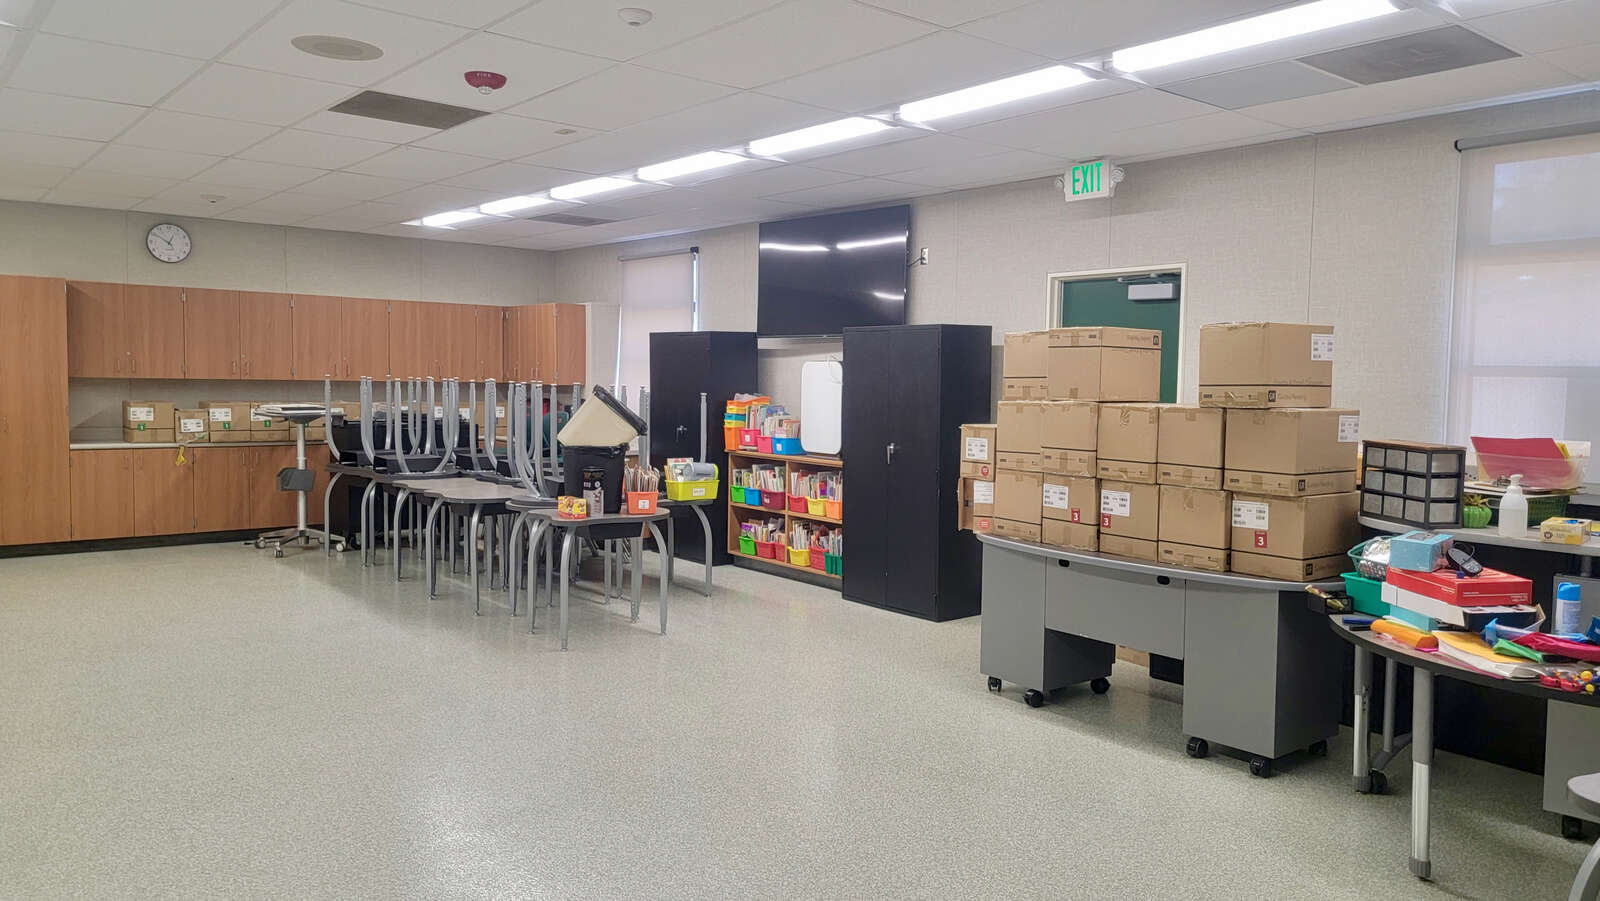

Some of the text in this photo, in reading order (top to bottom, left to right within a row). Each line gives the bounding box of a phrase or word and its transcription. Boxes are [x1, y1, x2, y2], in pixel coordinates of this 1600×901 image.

[1072, 161, 1103, 195] EXIT
[1073, 512, 1079, 521] 3
[1104, 518, 1109, 526] 3
[1258, 536, 1264, 546] 3
